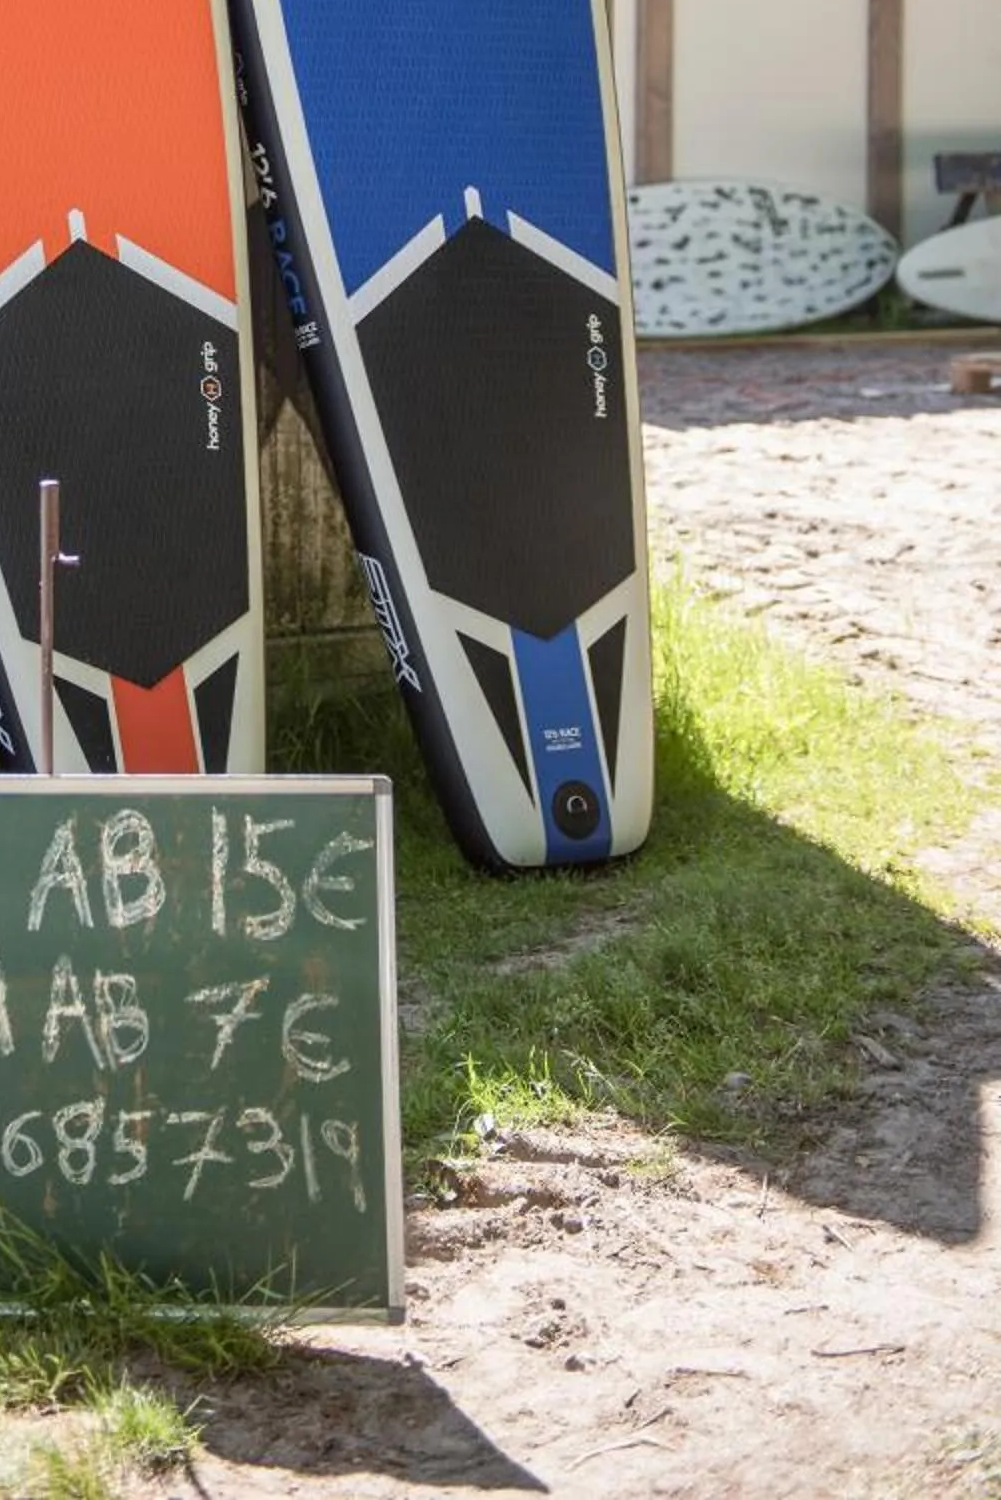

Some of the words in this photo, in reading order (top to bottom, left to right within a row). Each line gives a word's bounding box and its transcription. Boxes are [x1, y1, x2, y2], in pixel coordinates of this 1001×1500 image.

[269, 218, 306, 316] RACE
[585, 314, 604, 343] grip
[200, 341, 218, 373] grip
[593, 372, 607, 418] honey
[206, 401, 221, 450] honey
[28, 809, 167, 931] AB
[212, 805, 375, 940] 15€
